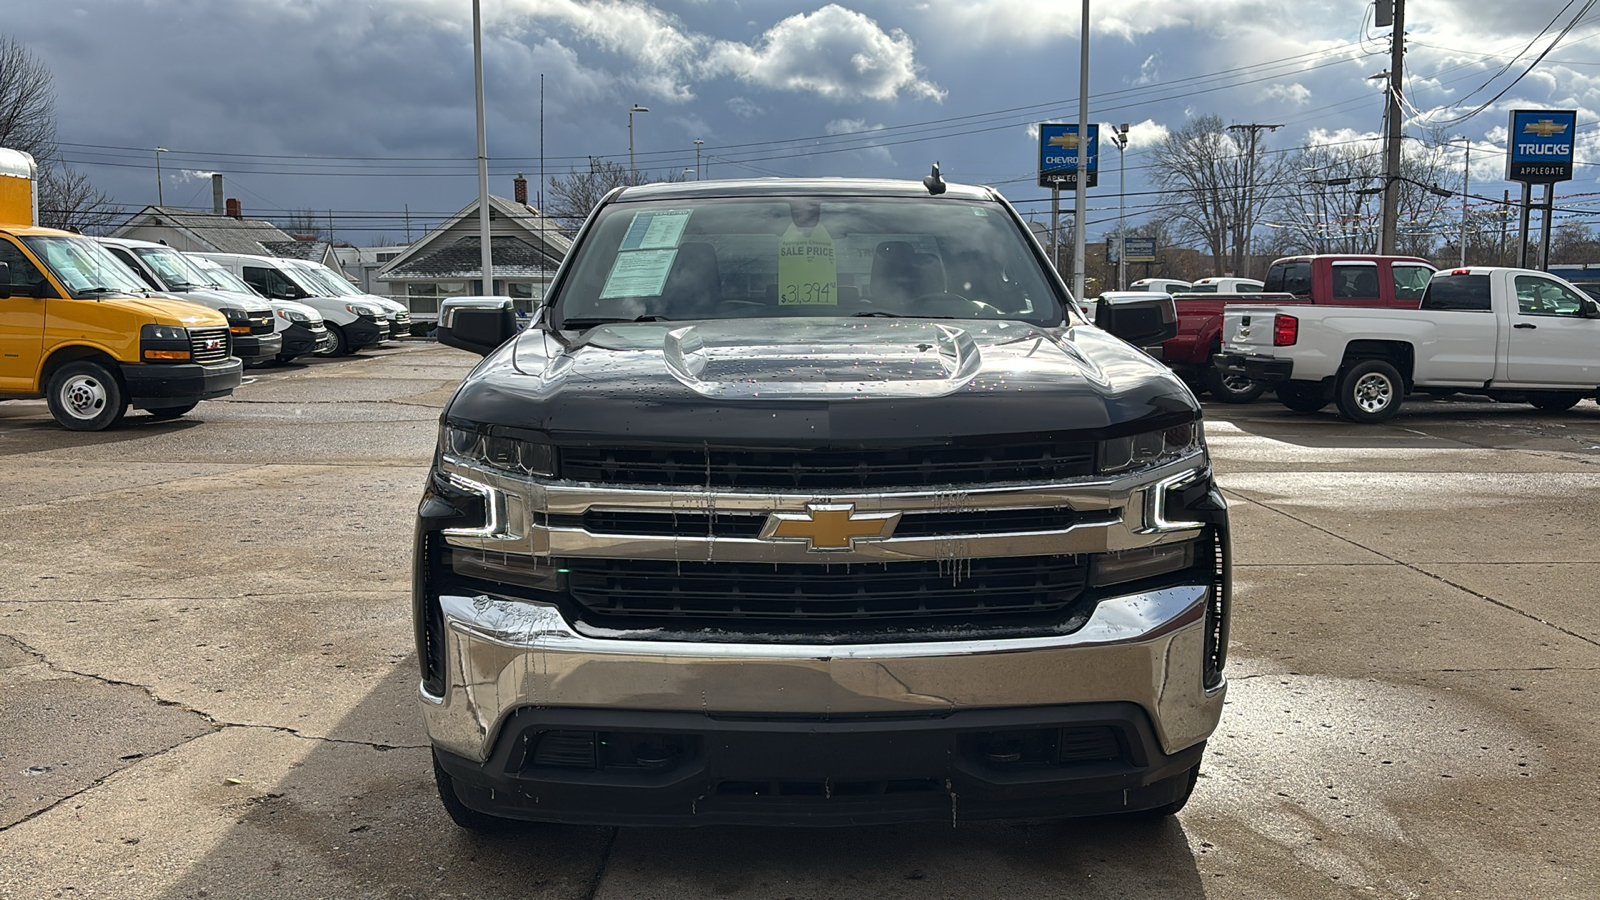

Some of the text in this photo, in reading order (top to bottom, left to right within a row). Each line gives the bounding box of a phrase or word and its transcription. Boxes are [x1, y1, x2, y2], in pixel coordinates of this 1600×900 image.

[1518, 143, 1570, 155] TRUCKS
[1046, 156, 1093, 164] CHEVROET
[1520, 167, 1564, 175] APPLEGATE
[780, 246, 834, 257] SALE PRICE
